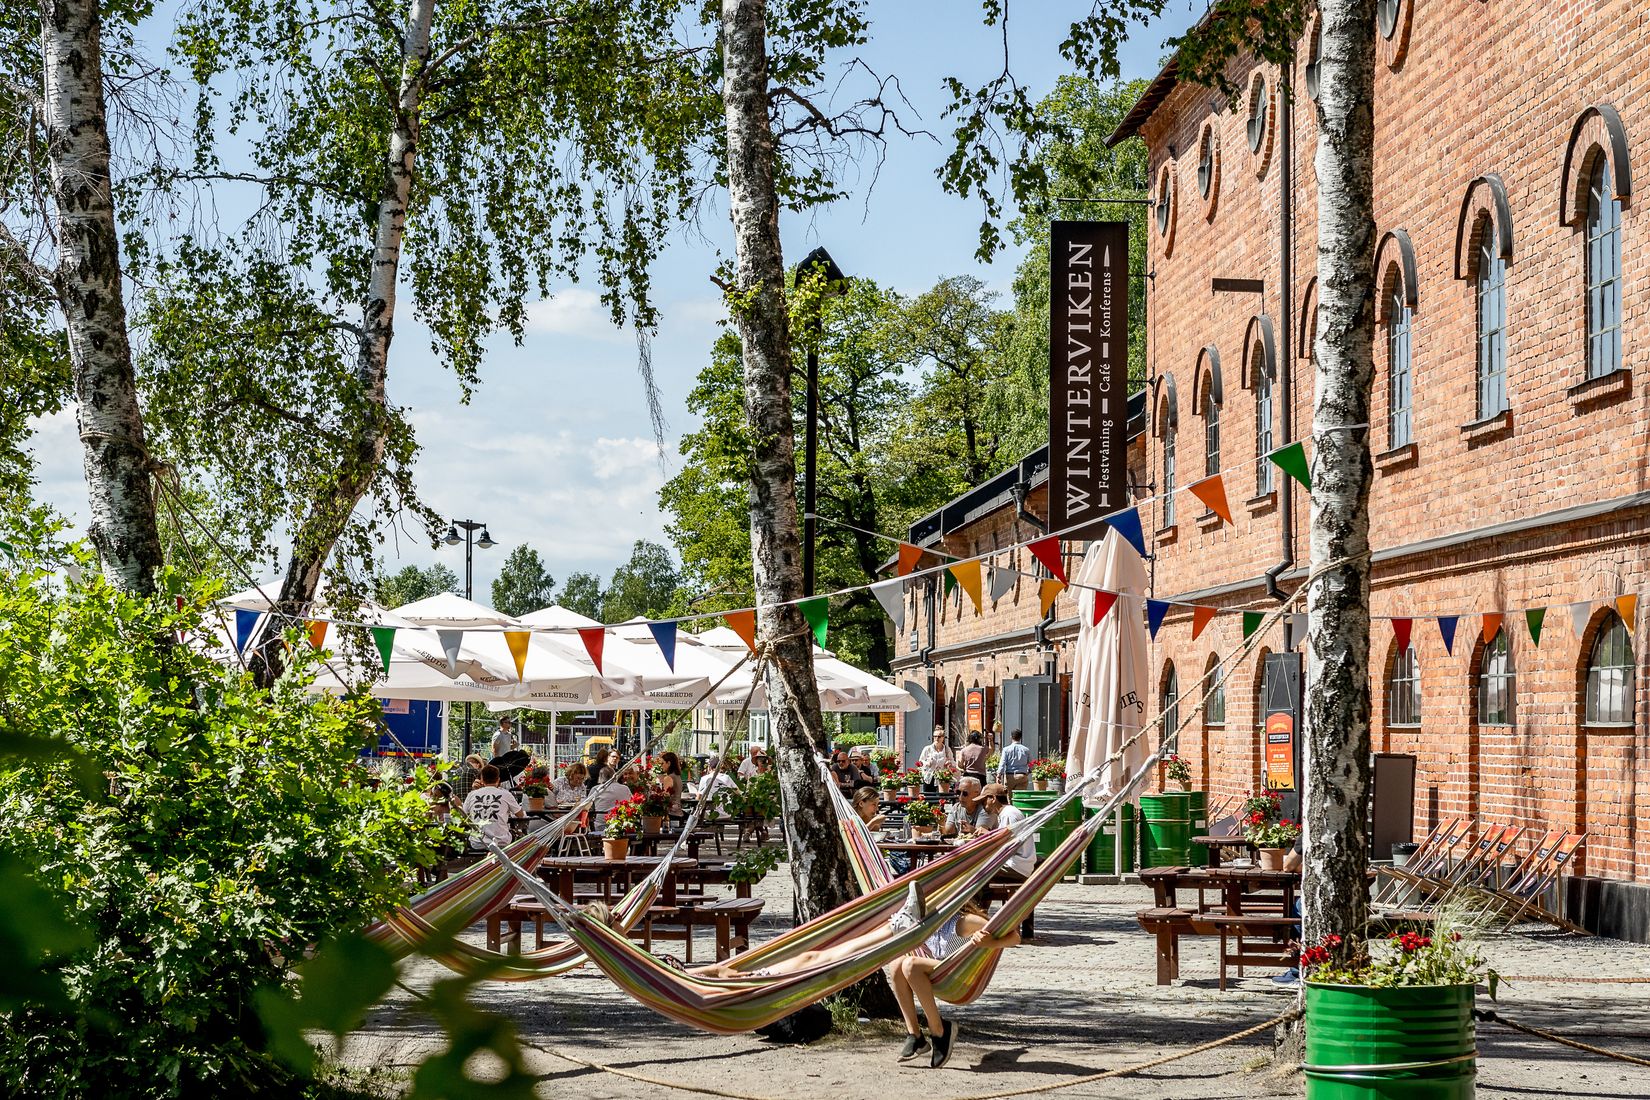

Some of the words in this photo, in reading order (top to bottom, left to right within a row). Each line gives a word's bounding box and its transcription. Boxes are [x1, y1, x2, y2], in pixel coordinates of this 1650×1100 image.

[1098, 272, 1112, 338] Konferens
[1065, 240, 1093, 520] WINTERVIKEN
[1098, 363, 1111, 393] Café
[1098, 419, 1113, 490] Festvåning
[530, 691, 579, 700] MELLERUDS
[649, 691, 694, 699] MELLERUDS
